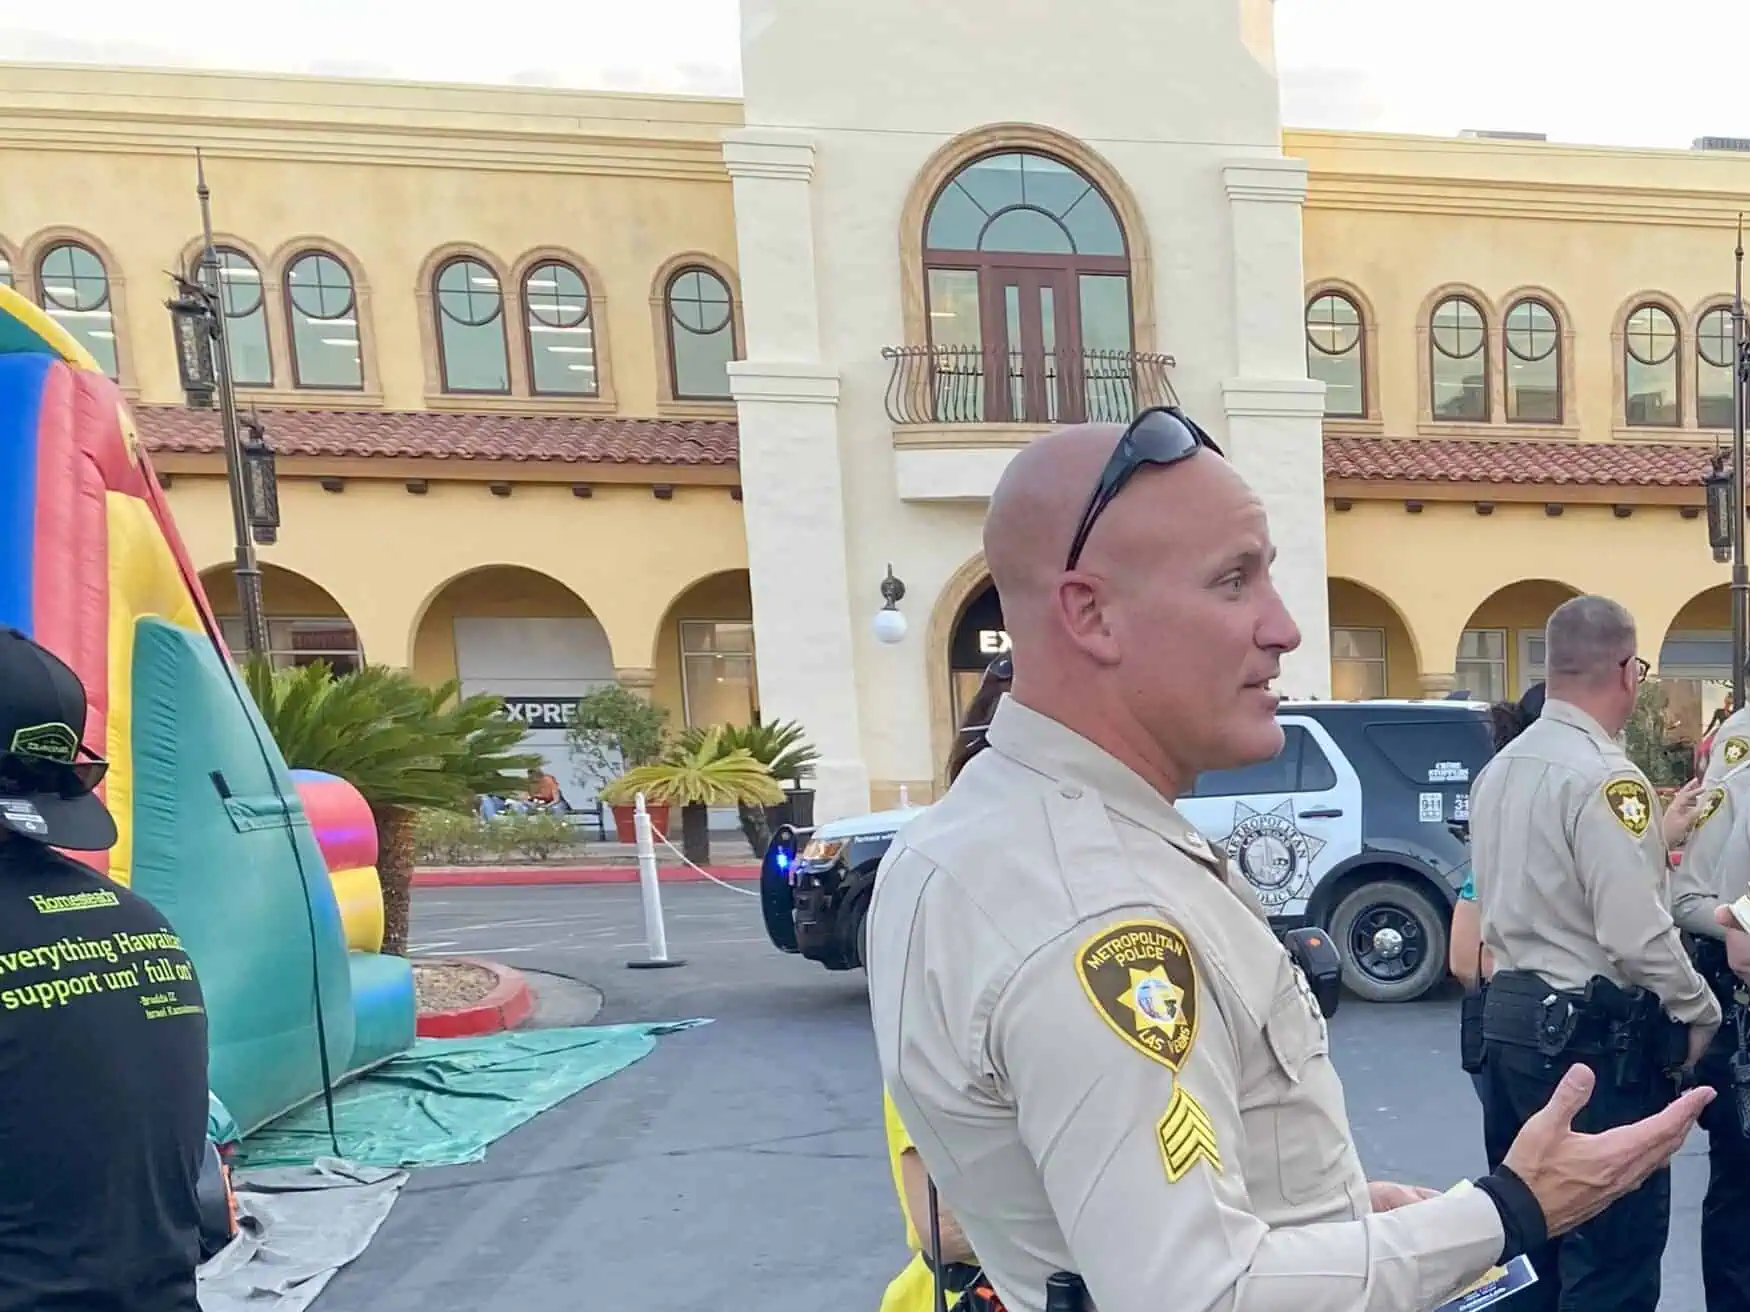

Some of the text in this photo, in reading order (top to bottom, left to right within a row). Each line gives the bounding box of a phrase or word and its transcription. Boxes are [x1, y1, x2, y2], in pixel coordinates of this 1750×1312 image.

[1255, 886, 1294, 905] OLICE
[0, 936, 118, 974] verything
[1086, 931, 1184, 971] METROPOLITAN
[1114, 945, 1165, 967] POLICE
[1, 972, 102, 1010] support
[143, 958, 176, 984] full
[1138, 1028, 1165, 1051] LAS
